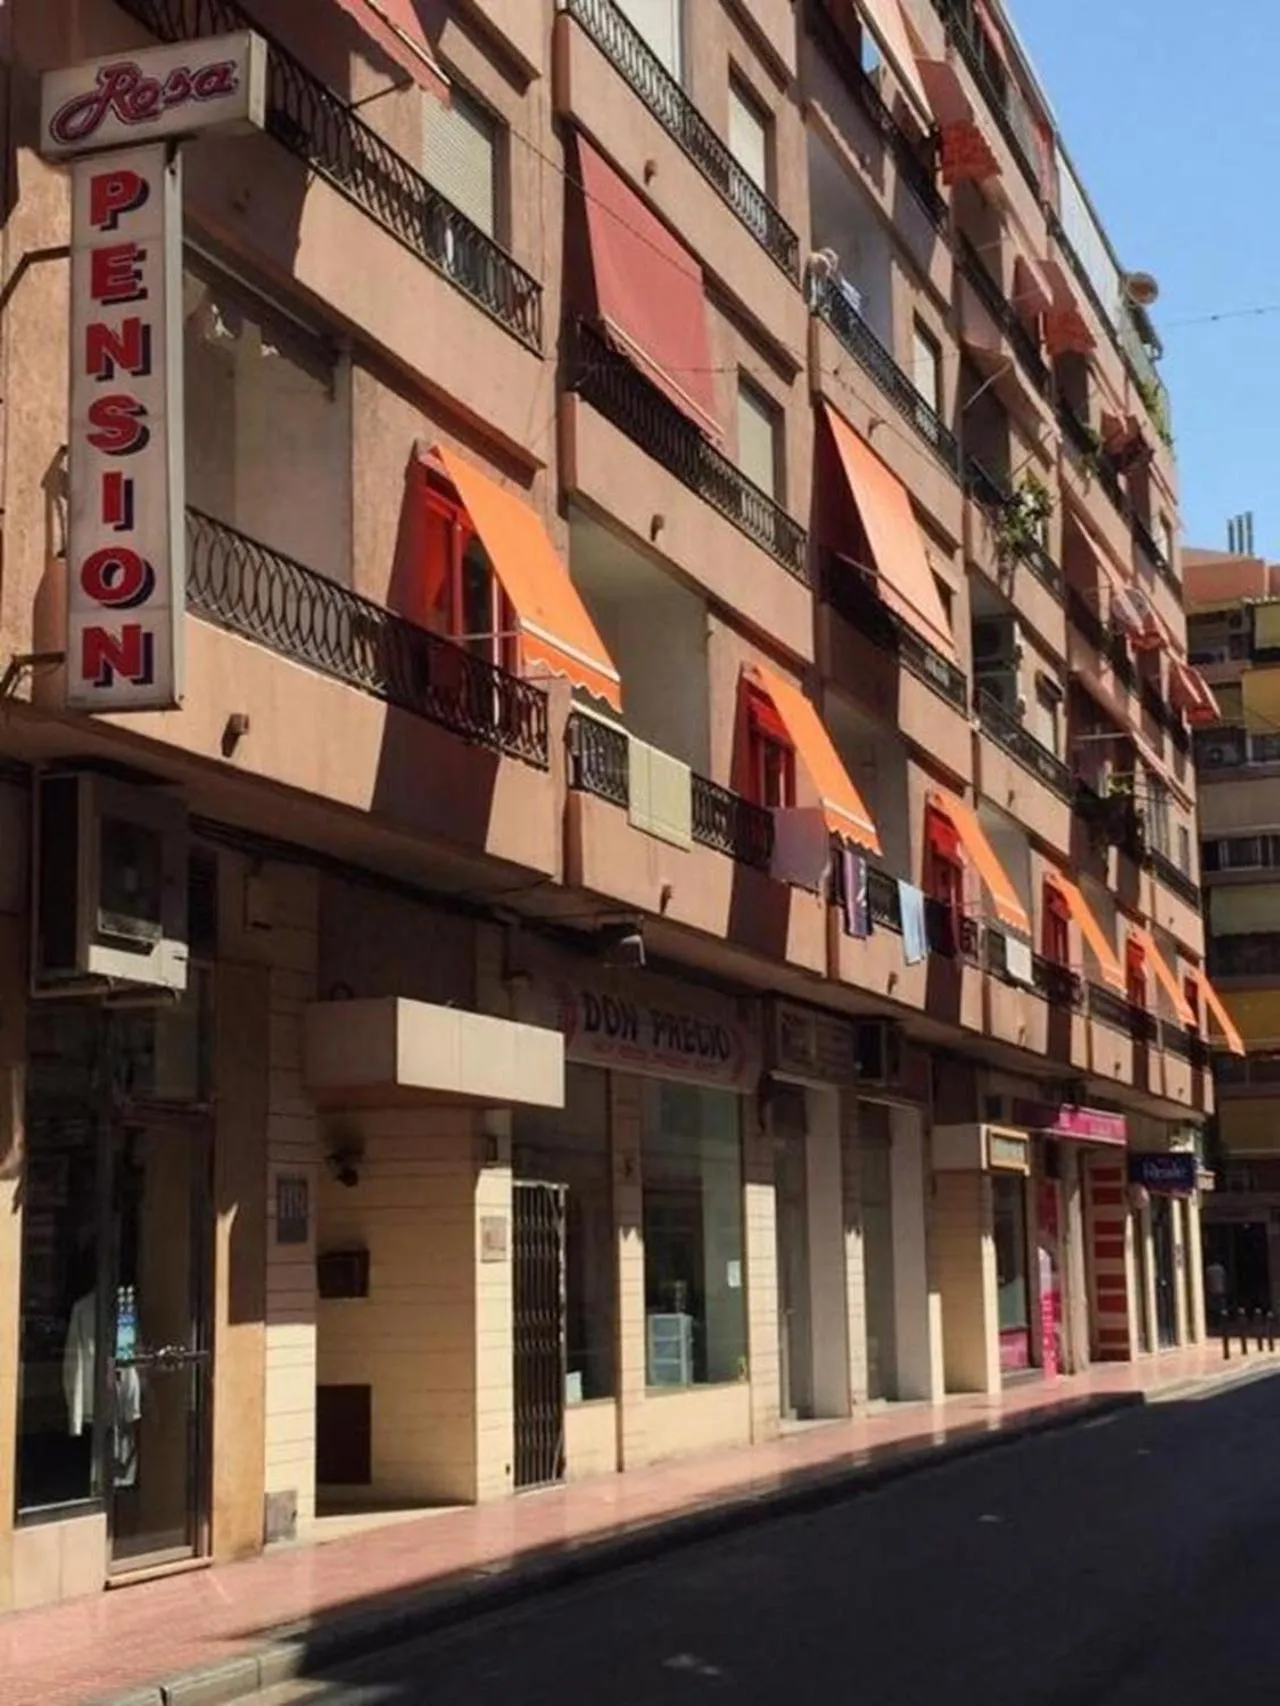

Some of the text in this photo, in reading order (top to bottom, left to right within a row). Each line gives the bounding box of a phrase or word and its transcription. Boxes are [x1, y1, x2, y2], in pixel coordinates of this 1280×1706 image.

[50, 61, 237, 144] Rosa
[80, 170, 155, 688] PENSION
[583, 991, 639, 1042] DON
[649, 1010, 732, 1062] PRECIO
